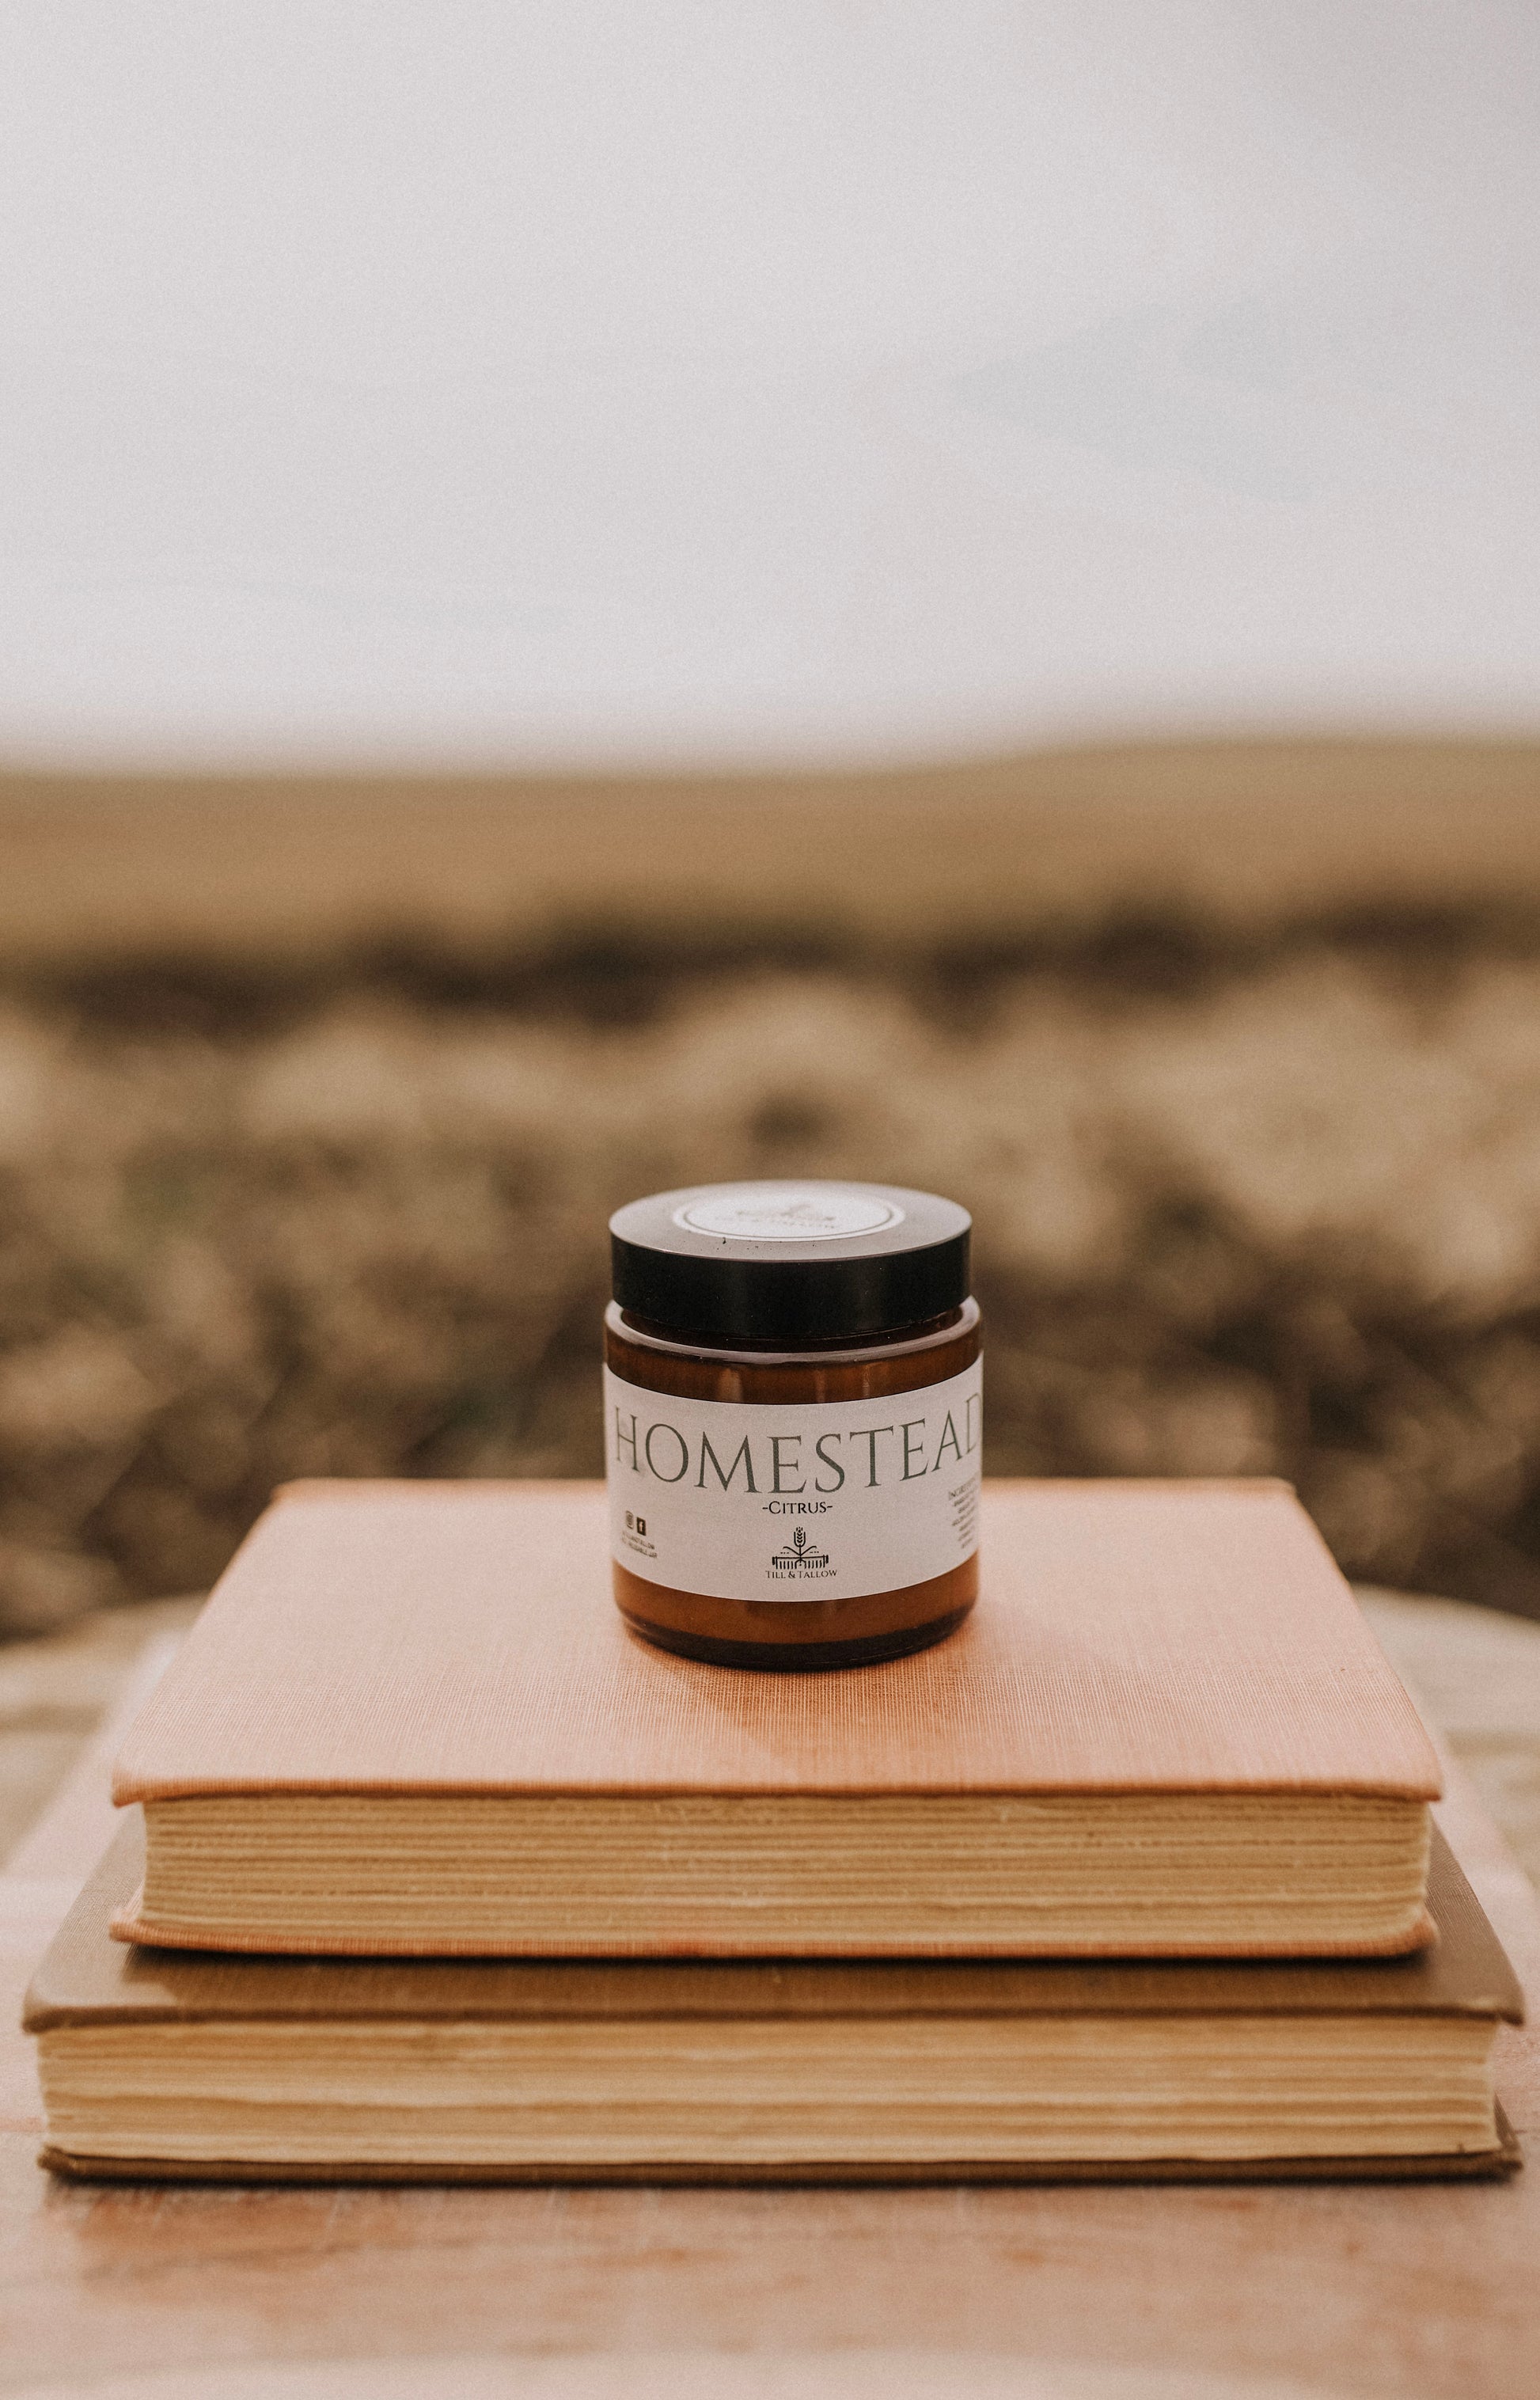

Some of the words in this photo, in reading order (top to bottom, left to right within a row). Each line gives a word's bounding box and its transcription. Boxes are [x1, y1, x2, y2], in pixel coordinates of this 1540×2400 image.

[615, 1392, 981, 1493] HOMESTEAD
[765, 1570, 786, 1579] TILL
[788, 1570, 796, 1579] &
[797, 1570, 837, 1579] TALLOW
